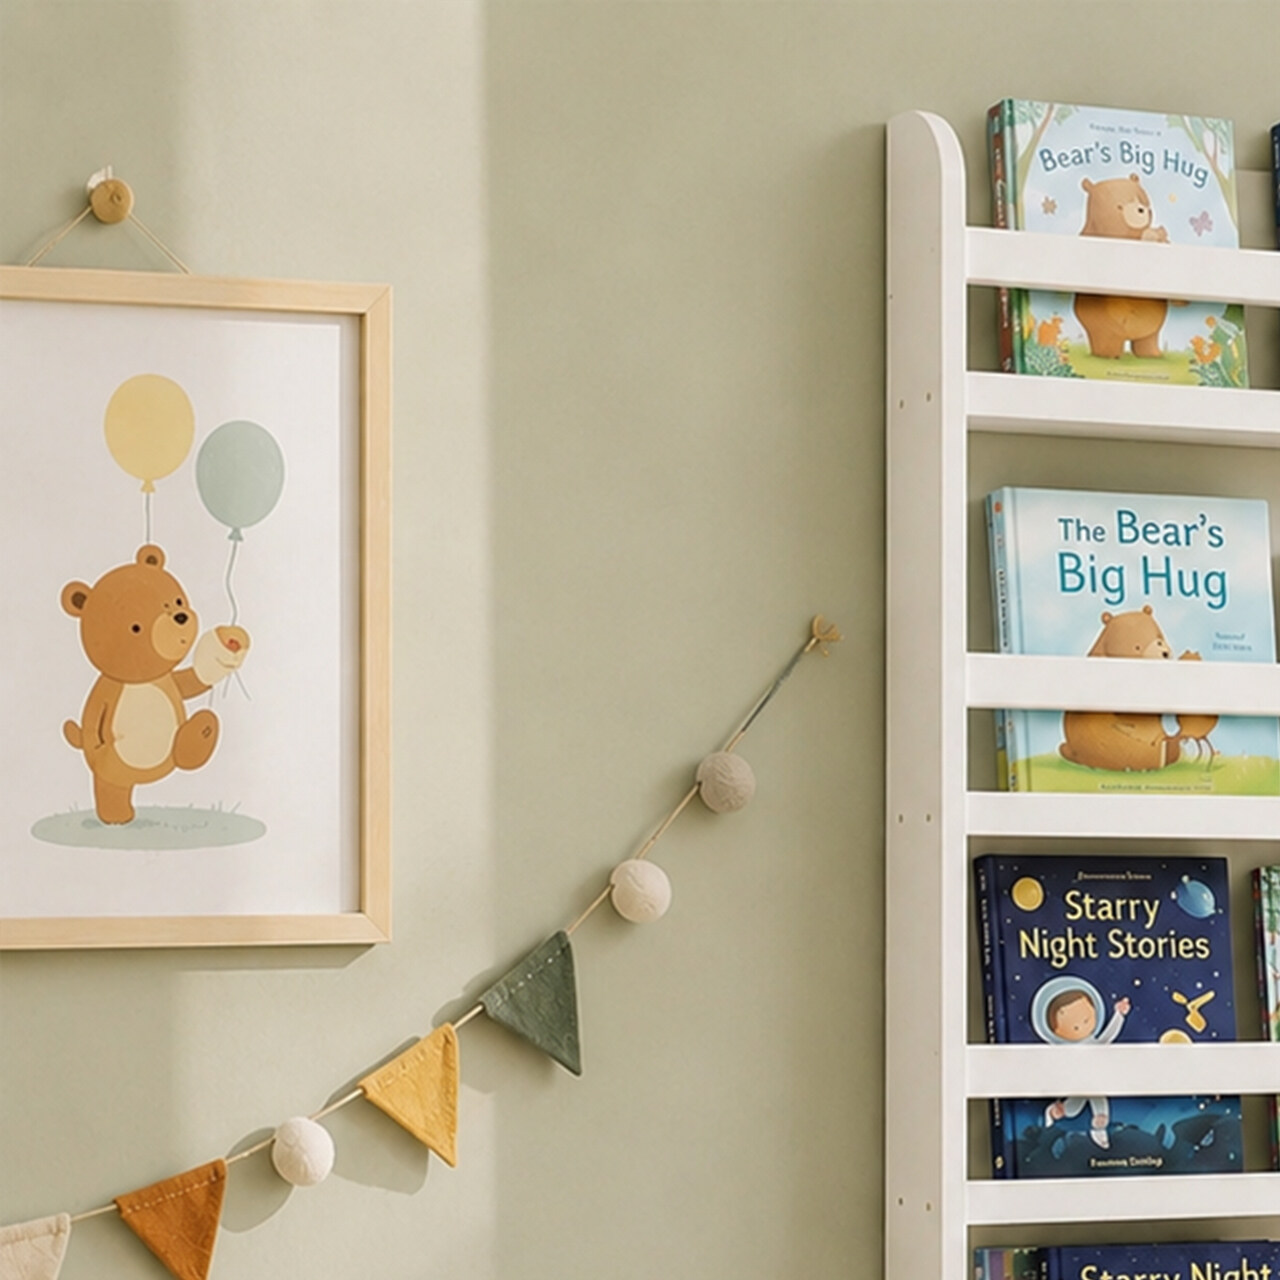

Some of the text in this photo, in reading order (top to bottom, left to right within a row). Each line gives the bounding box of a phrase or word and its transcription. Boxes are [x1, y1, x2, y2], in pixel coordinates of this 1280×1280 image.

[1039, 141, 1208, 188] Bear's Big Hug
[1058, 510, 1224, 548] The Bear's
[1057, 552, 1227, 610] Big Hug
[1065, 890, 1159, 930] Starry
[1019, 927, 1210, 969] Night Stories
